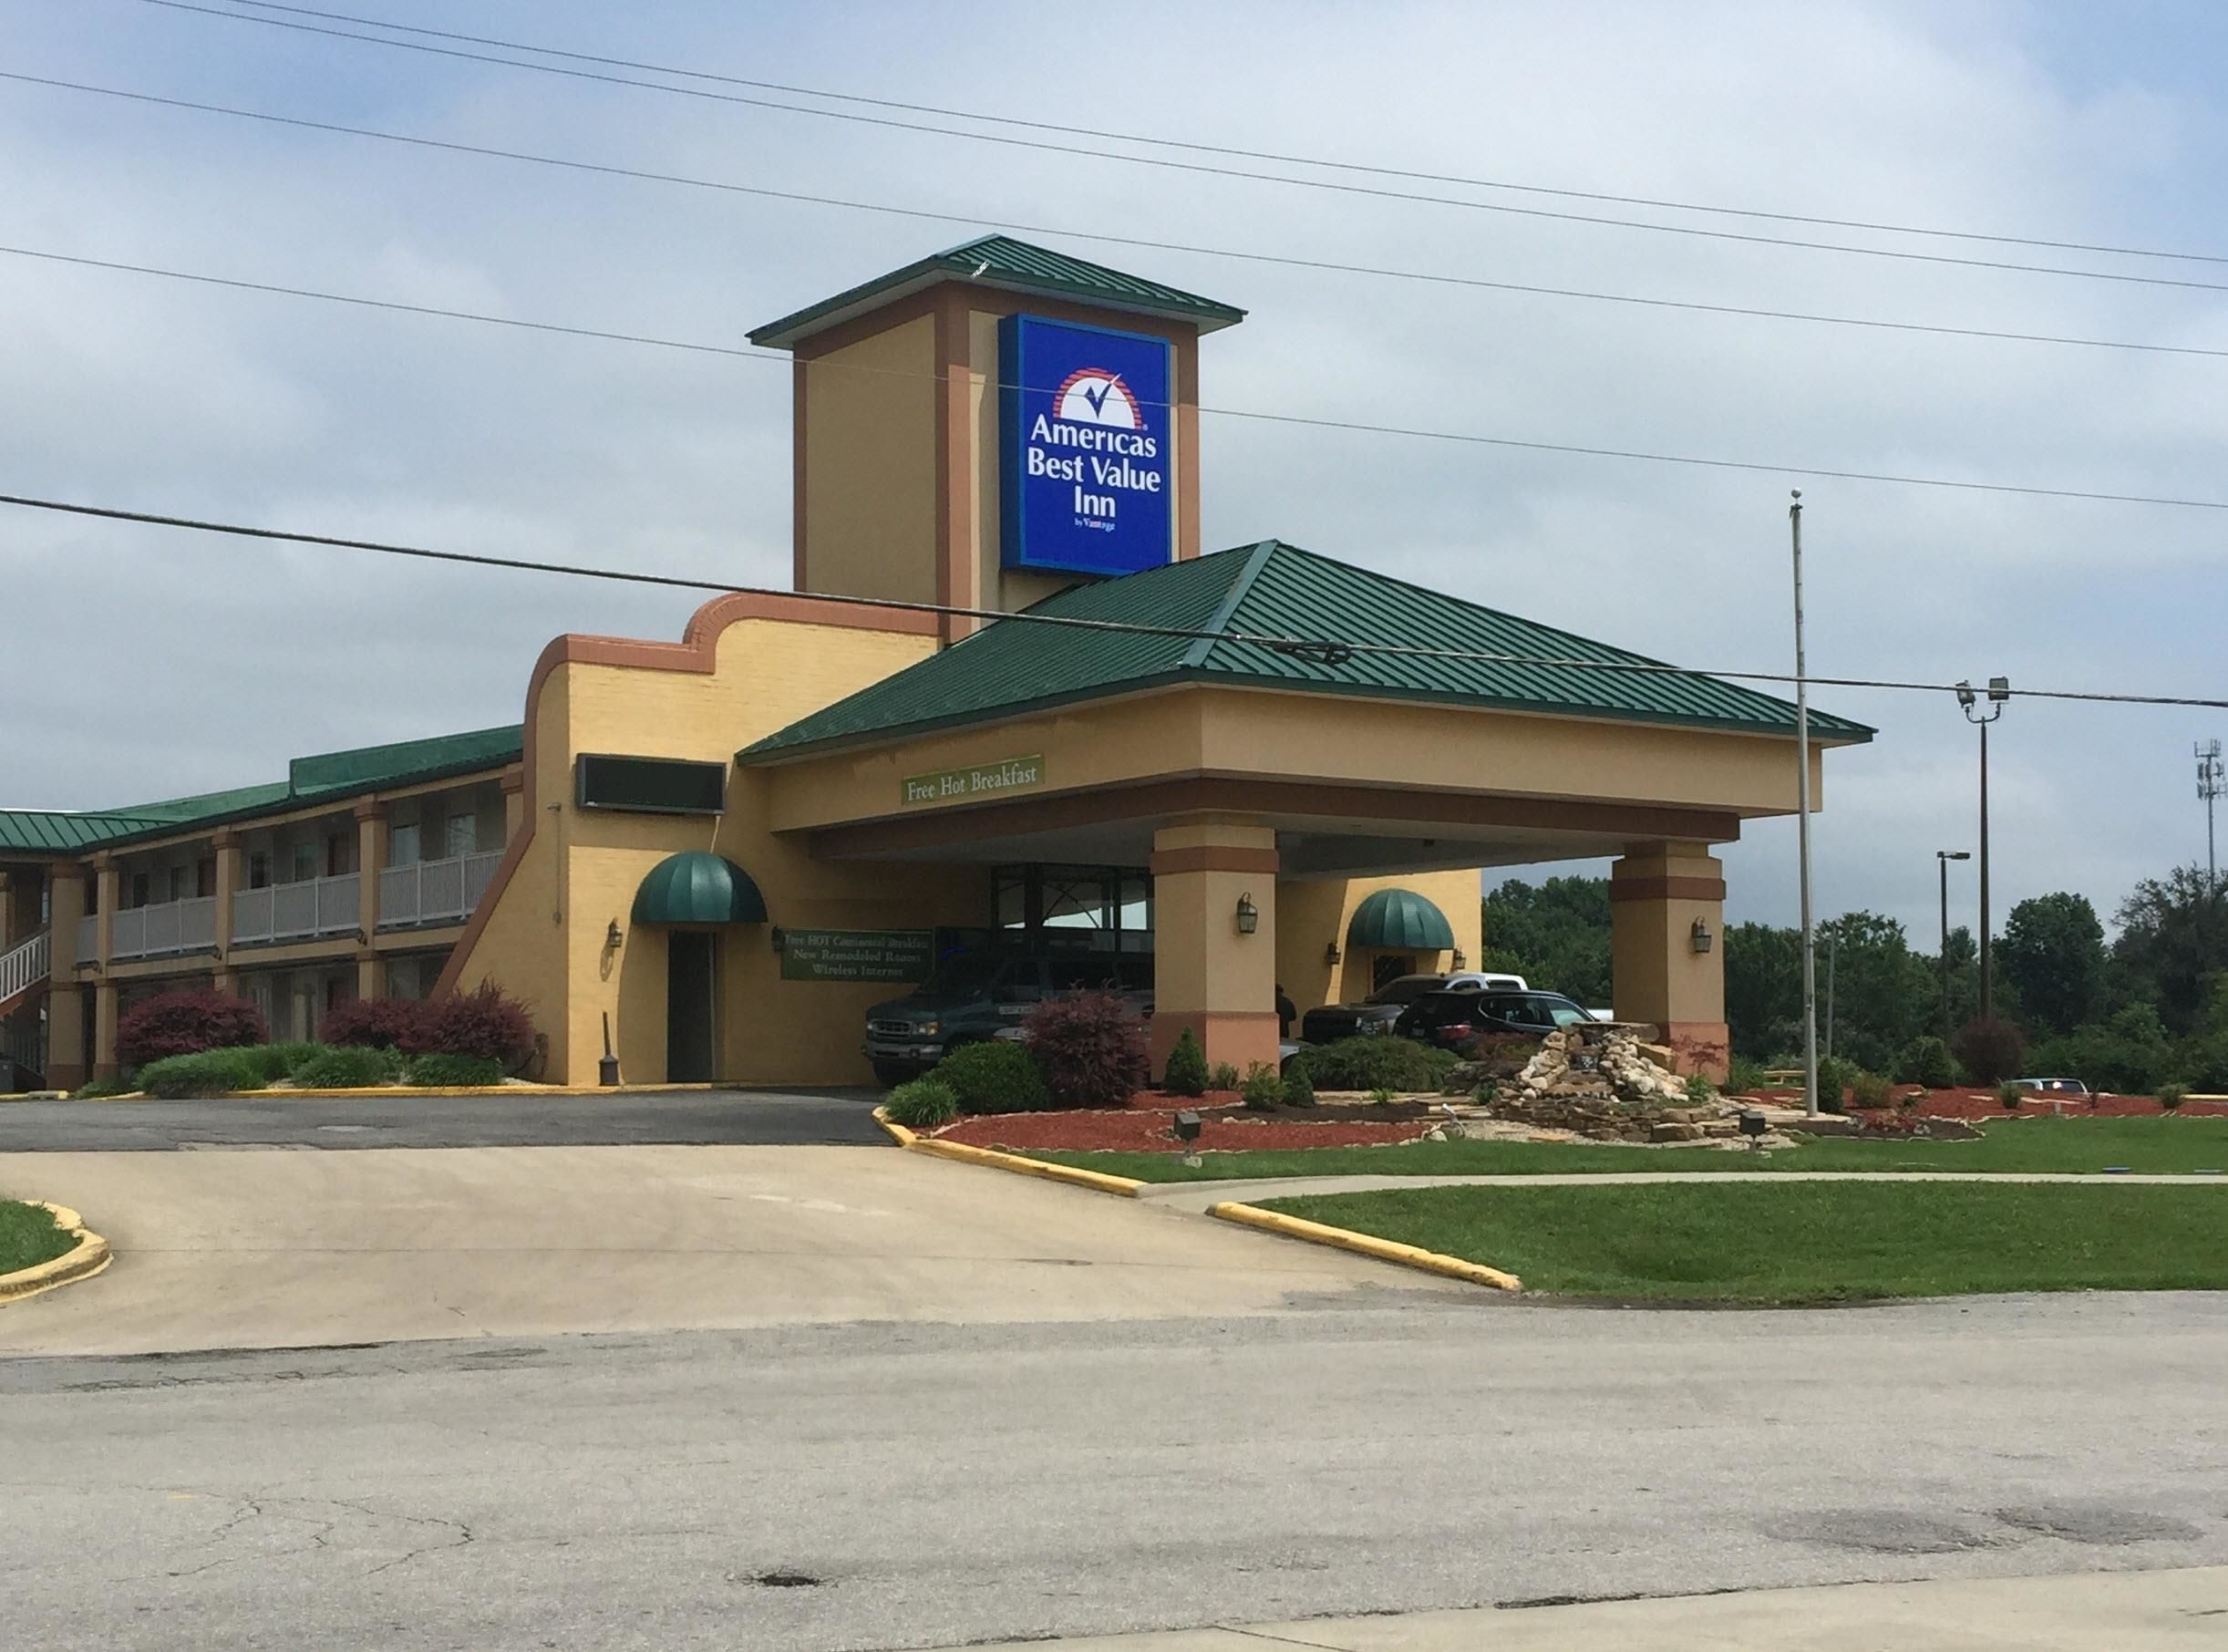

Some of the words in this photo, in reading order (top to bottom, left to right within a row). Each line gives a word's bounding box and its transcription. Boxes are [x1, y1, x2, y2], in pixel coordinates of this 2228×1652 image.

[1031, 413, 1157, 458] Americas
[1028, 447, 1084, 482] Best
[1090, 456, 1161, 492] Value
[1075, 485, 1116, 518] Inn
[907, 782, 935, 801] Free
[941, 776, 965, 796] Hot
[971, 763, 1037, 791] Breakfast
[785, 934, 804, 945] Free
[808, 934, 831, 946] HOT
[793, 949, 817, 959] New
[821, 949, 882, 962] Remodeled
[885, 951, 921, 963] Rooms
[811, 964, 857, 976] Wireless
[861, 965, 903, 977] Internet
